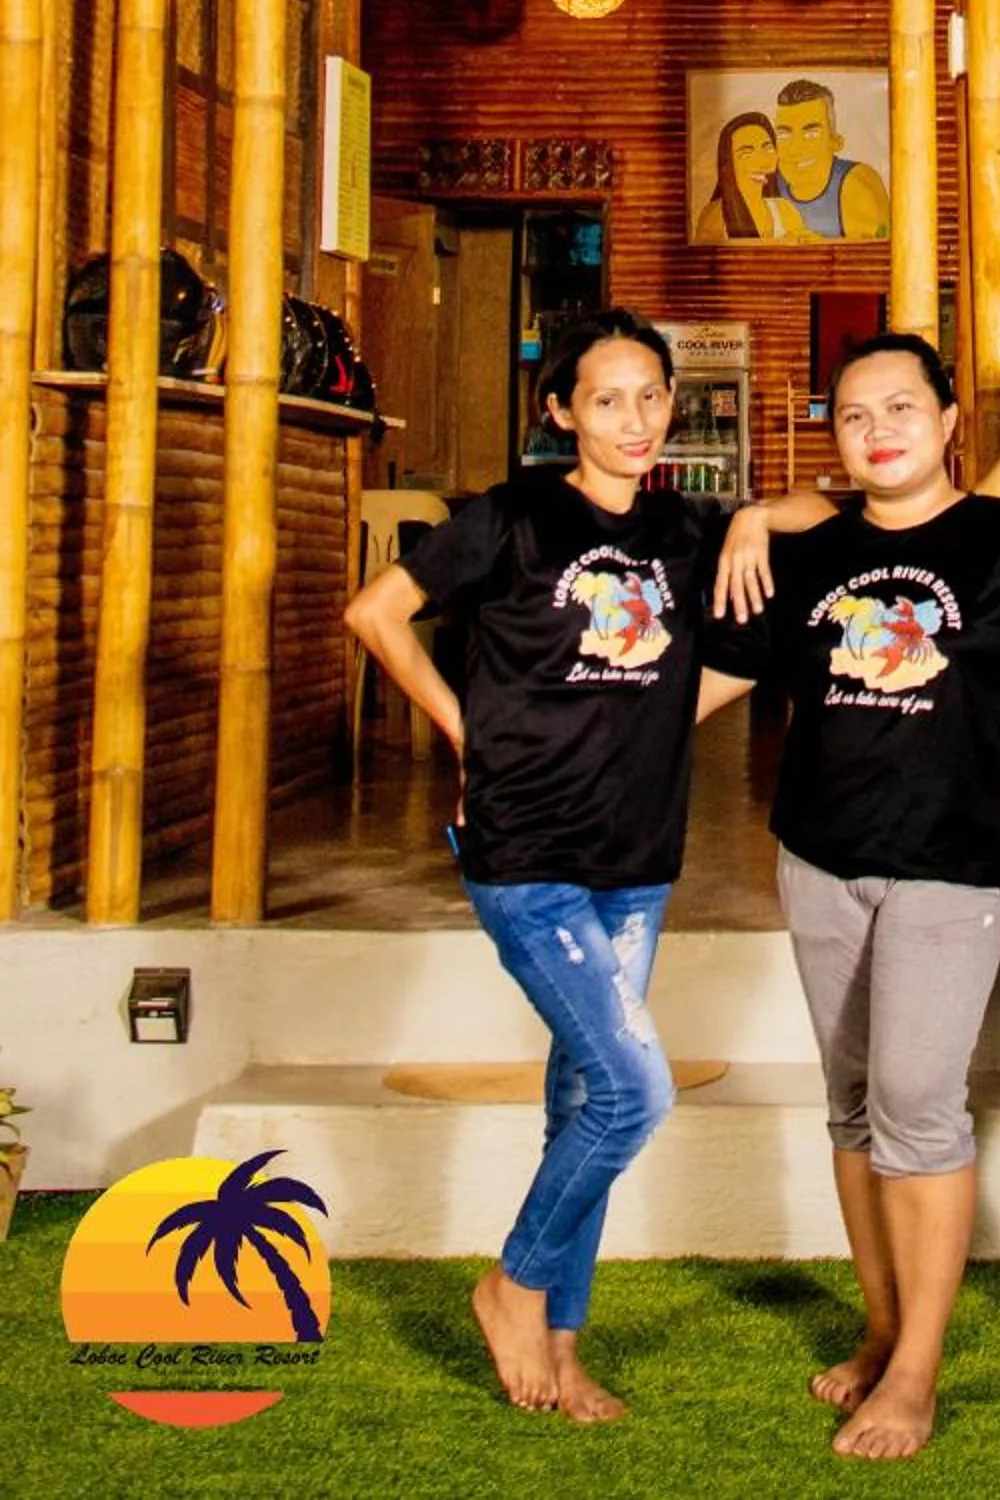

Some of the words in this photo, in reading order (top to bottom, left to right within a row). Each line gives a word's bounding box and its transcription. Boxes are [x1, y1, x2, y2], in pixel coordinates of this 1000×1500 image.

[847, 567, 890, 590] COOL
[891, 564, 936, 587] RIVER
[926, 578, 963, 631] RESORT
